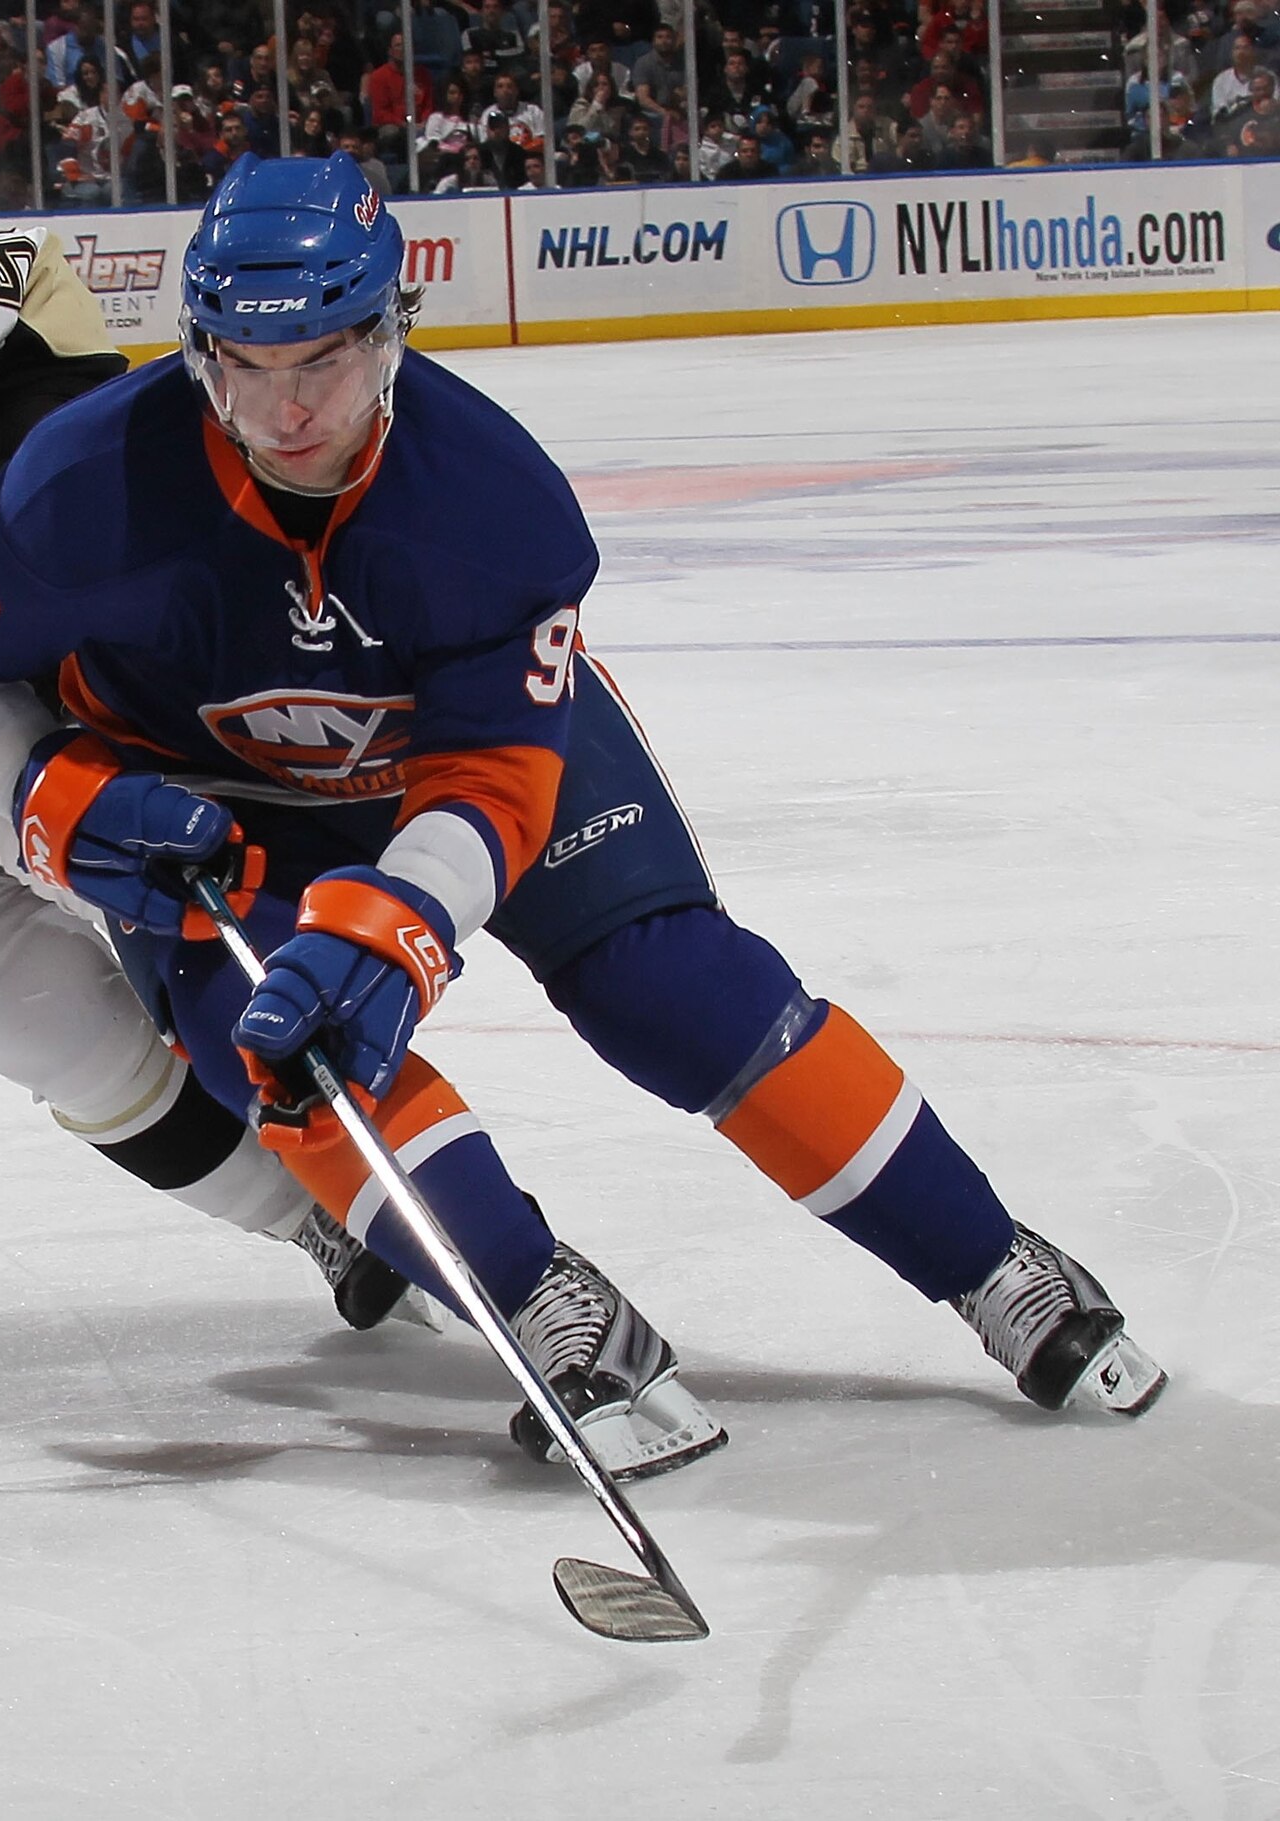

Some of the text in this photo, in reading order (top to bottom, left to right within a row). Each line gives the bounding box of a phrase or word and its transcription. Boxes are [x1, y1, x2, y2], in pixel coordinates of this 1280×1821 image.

[538, 220, 728, 269] NHL.COM
[896, 196, 1224, 275] NYLIhonda.com
[63, 235, 166, 293] ders
[1036, 266, 1216, 281] New York Long Island Honda Dealers
[235, 298, 308, 313] CCM
[525, 604, 575, 706] 9
[242, 704, 388, 778] NY
[552, 808, 638, 858] CCM
